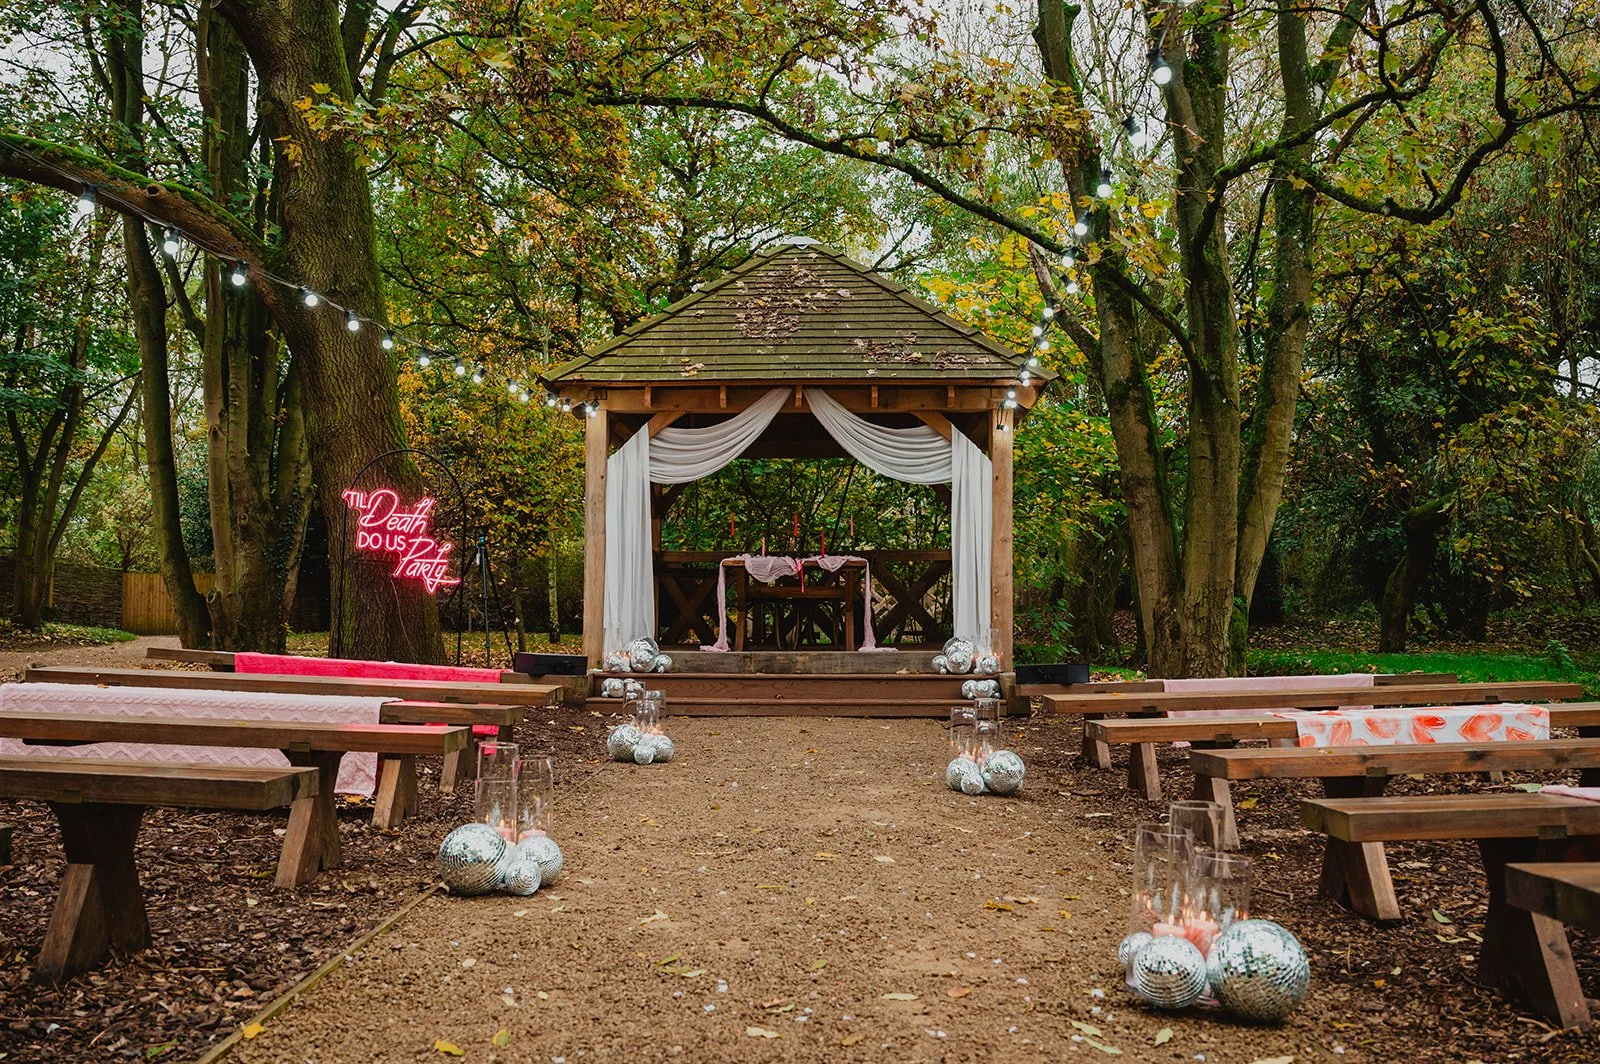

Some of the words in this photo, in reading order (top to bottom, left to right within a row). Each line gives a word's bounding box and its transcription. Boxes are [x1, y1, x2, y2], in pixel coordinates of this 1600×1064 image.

[360, 489, 434, 533] Death
[358, 532, 382, 549] DO
[386, 534, 406, 550] US
[395, 536, 460, 593] Party
